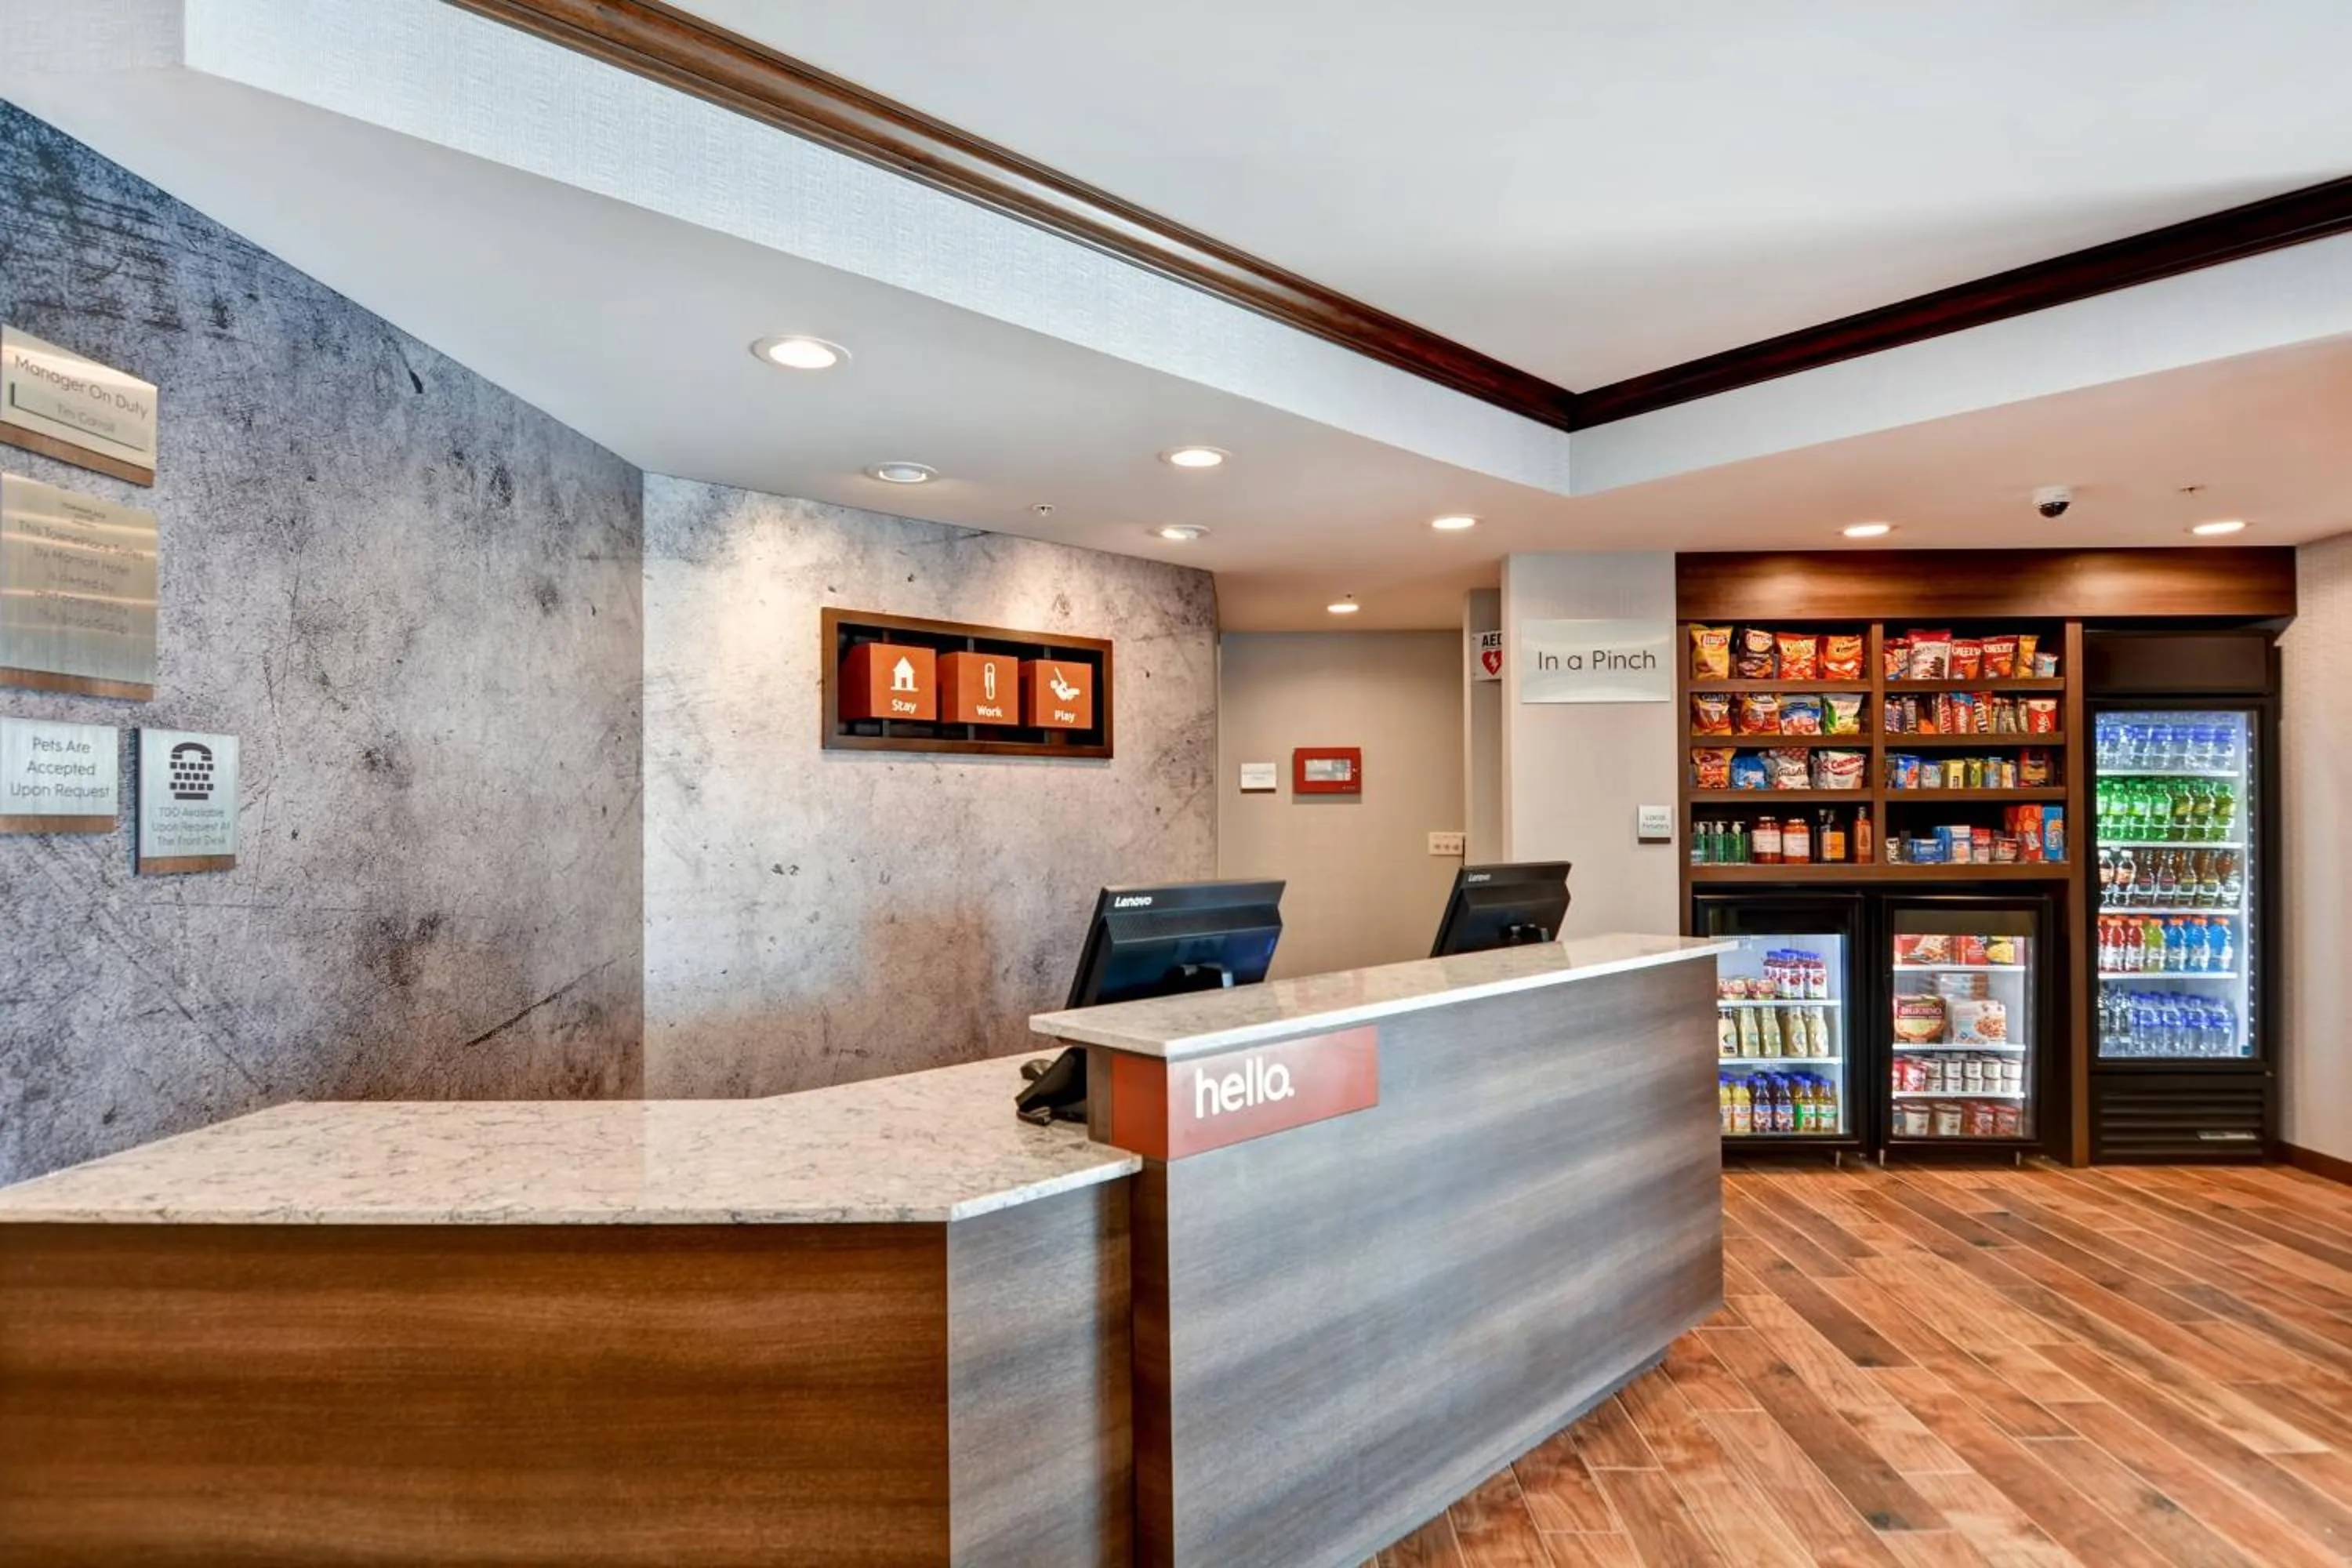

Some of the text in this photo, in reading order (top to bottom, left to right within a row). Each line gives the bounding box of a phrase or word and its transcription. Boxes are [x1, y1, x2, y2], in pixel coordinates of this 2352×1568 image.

[14, 354, 148, 419] Manager On Duty
[1538, 649, 1657, 670] In a Pinch
[891, 699, 916, 714] Stay
[976, 704, 1003, 718] Work
[1054, 709, 1075, 724] Play
[32, 737, 91, 753] Pets Are
[27, 760, 96, 777] Accepted
[10, 783, 110, 798] Upon Request
[158, 807, 180, 818] TDD
[1468, 873, 1492, 884] Lenovo
[1114, 894, 1153, 909] Lenovo
[1196, 1056, 1295, 1120] hello.
